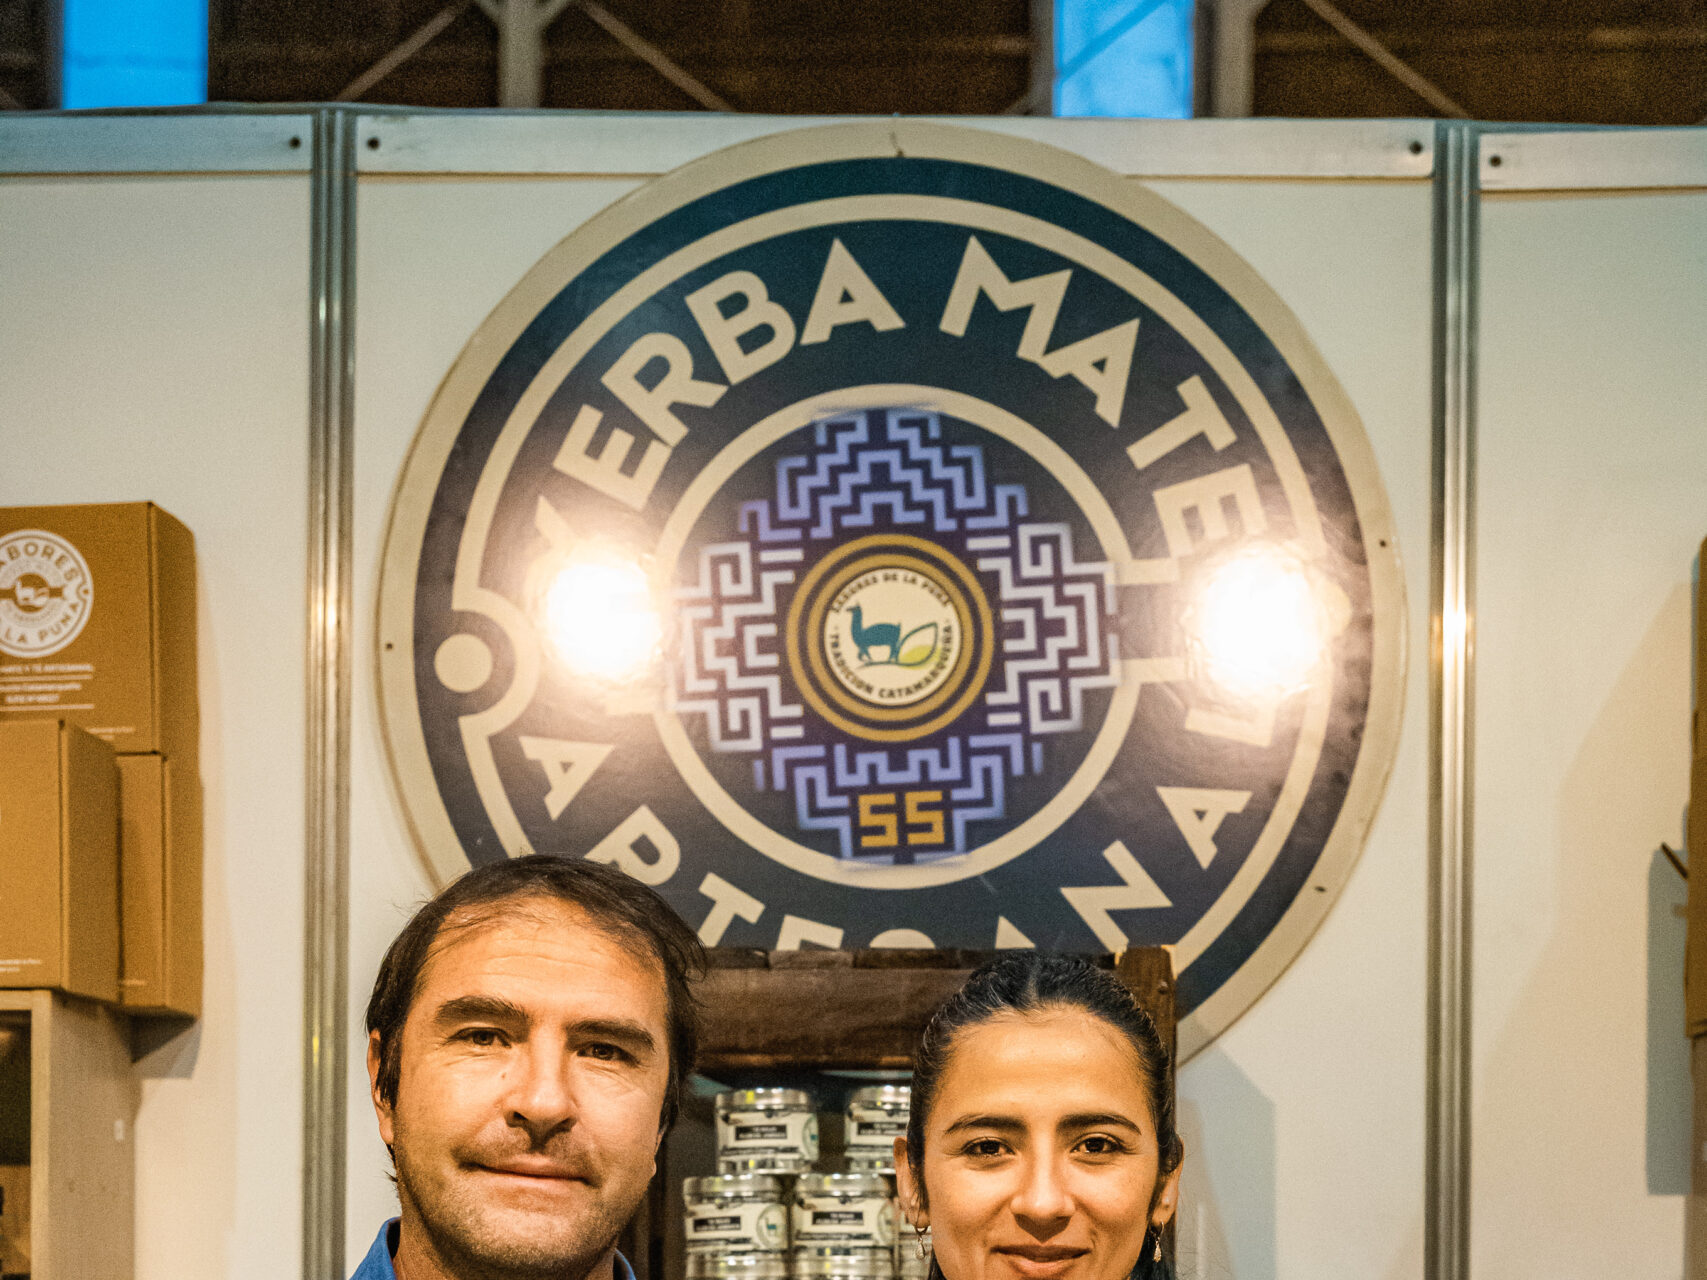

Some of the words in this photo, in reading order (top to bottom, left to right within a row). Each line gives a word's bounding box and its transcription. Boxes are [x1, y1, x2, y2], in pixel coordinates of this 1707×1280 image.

[939, 234, 1268, 558] MATE
[0, 541, 78, 581] BORES
[37, 602, 78, 642] PUNA
